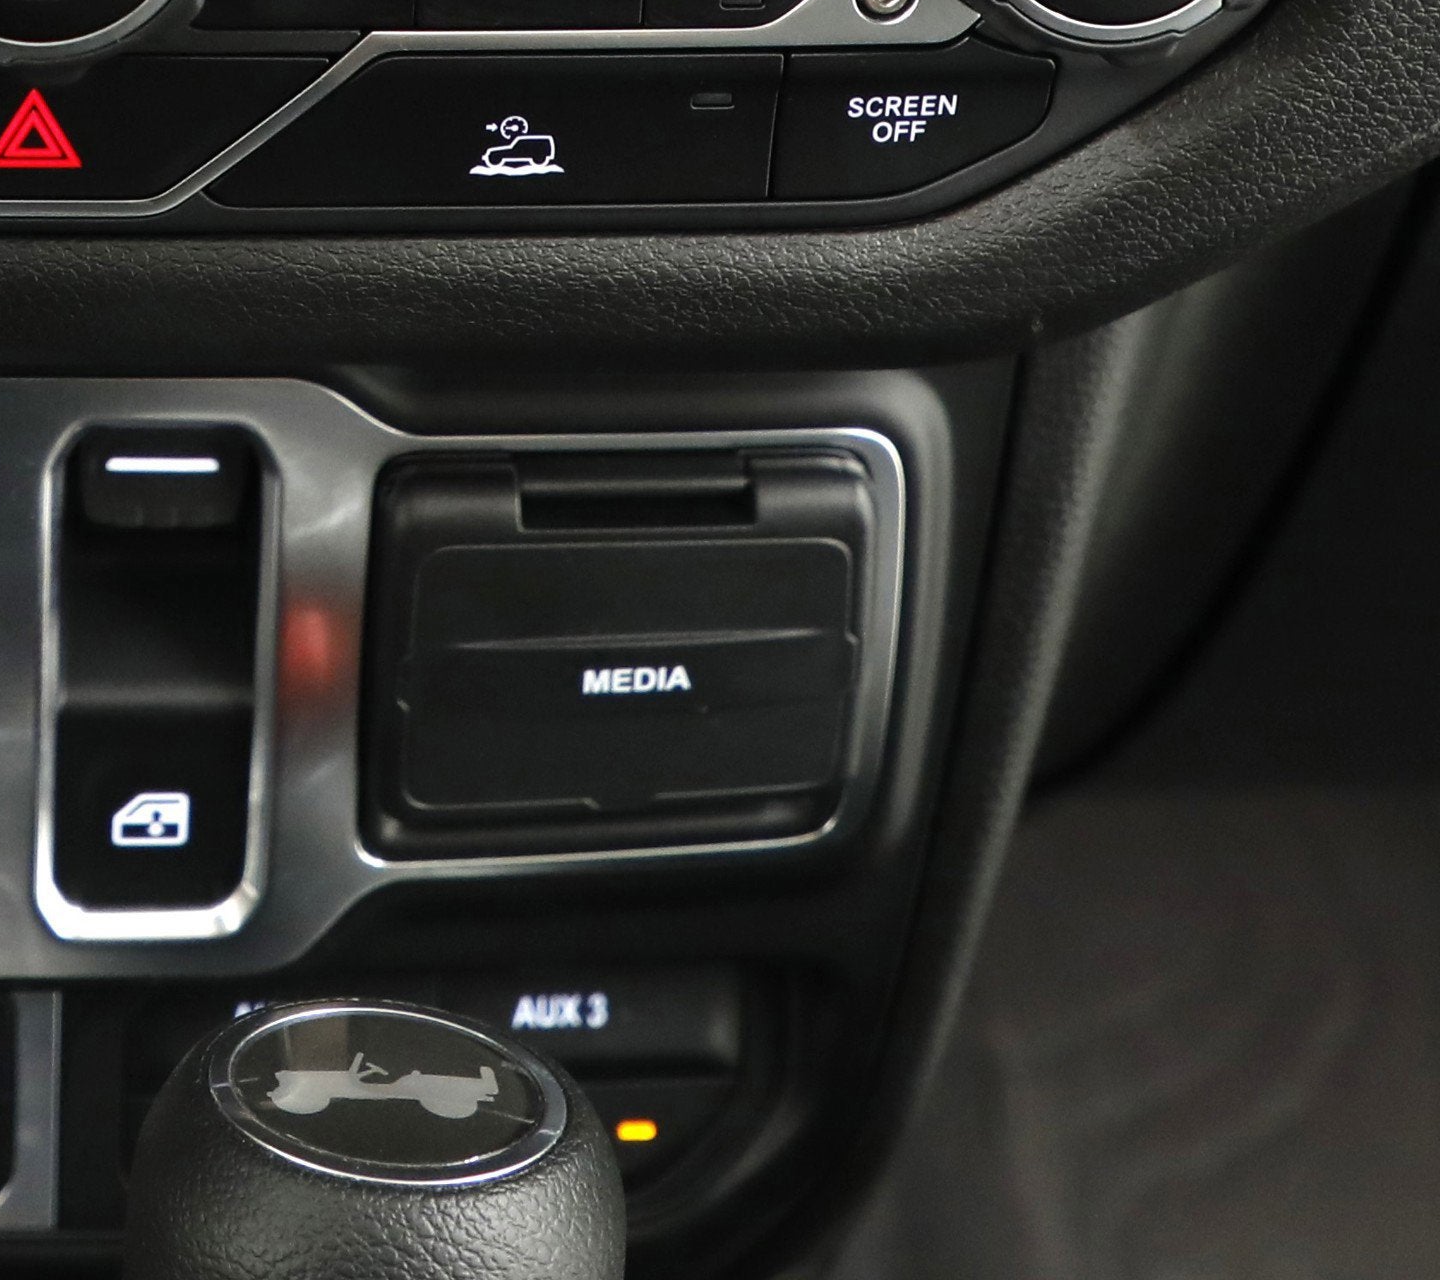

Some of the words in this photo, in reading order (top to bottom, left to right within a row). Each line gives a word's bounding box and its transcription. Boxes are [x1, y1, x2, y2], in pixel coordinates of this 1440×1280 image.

[847, 95, 957, 117] SCREEN
[872, 121, 926, 142] OFF
[582, 665, 691, 694] MEDIA
[513, 994, 581, 1028] AUX
[586, 994, 608, 1026] 3
